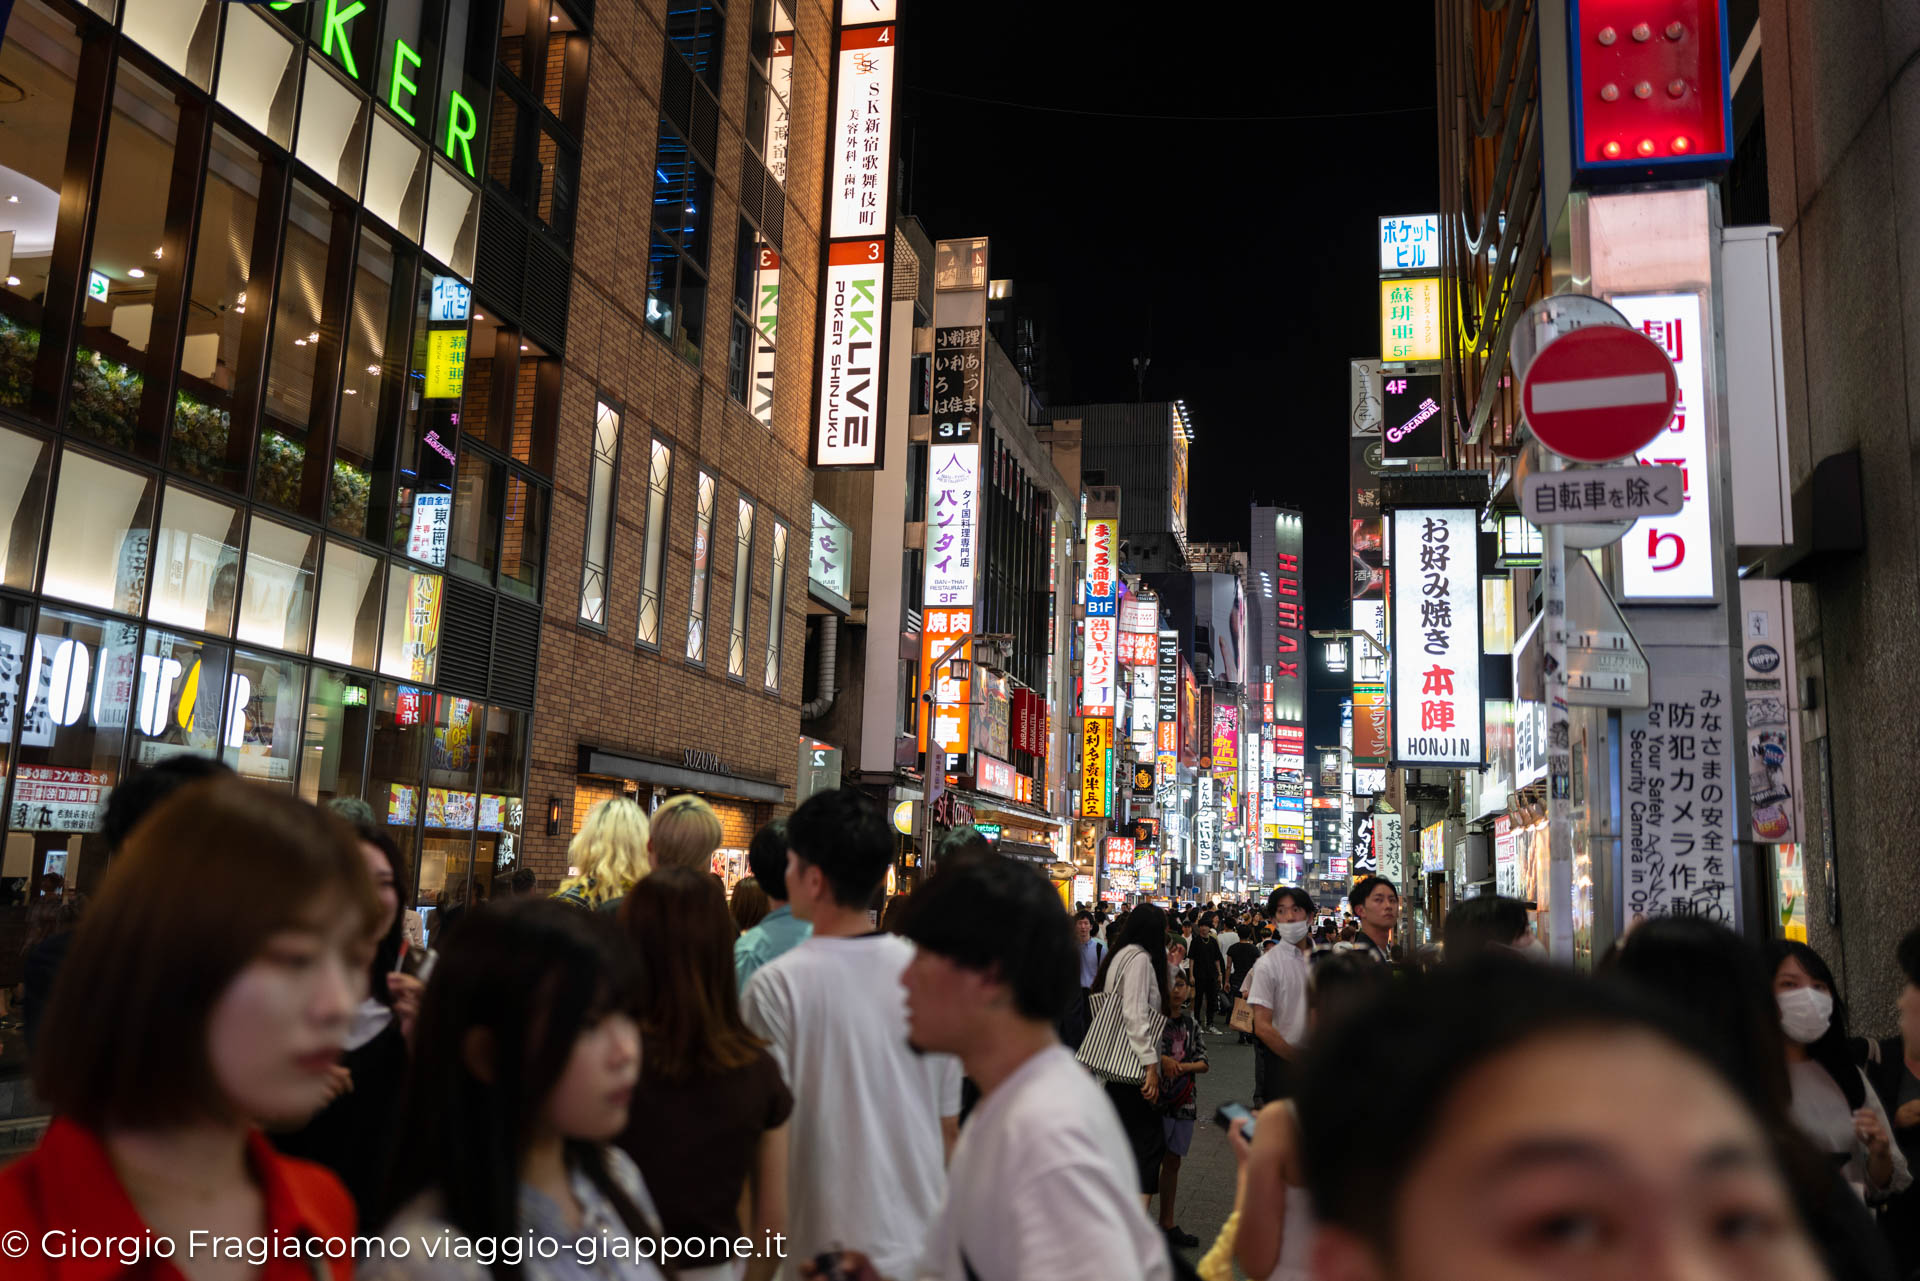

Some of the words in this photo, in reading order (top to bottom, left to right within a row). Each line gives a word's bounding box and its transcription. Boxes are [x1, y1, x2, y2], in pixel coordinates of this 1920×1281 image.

[877, 27, 890, 44] 4
[271, 0, 476, 178] KER
[843, 108, 860, 200] 美容外科・歯科
[858, 82, 881, 226] SK新宿歌舞伎町
[1383, 218, 1436, 244] ポケット
[867, 243, 880, 261] 3
[1396, 244, 1426, 268] ビル
[831, 280, 846, 347] POKER
[936, 329, 981, 348] 小料理
[843, 278, 876, 448] KKLIVE
[827, 353, 841, 449] SHINJUKU
[934, 356, 950, 416] いろは
[963, 353, 980, 414] あづま
[1385, 379, 1408, 395] 4F
[938, 421, 973, 438] 3F
[1386, 403, 1441, 443] G-SCANDAL
[1535, 477, 1670, 514] 自転車を除く
[933, 488, 958, 574] バンタイ
[959, 489, 972, 568] タイ国料理専門店
[1091, 523, 1112, 598] まぐろ商店
[939, 593, 958, 603] 3F
[1420, 516, 1452, 656] お好み焼き
[926, 612, 971, 633] 焼肉
[1087, 601, 1114, 613] B1F
[1090, 706, 1107, 716] 4F
[1421, 664, 1456, 733] 本陣
[1648, 702, 1665, 729] For
[683, 747, 720, 772] SUZUYA
[945, 753, 959, 771] F
[1407, 737, 1471, 757] HONJIN
[1627, 729, 1647, 796] Security
[1648, 735, 1665, 771] Your
[1645, 777, 1665, 828] Safety
[1630, 801, 1647, 863] Camera
[1630, 869, 1647, 884] in
